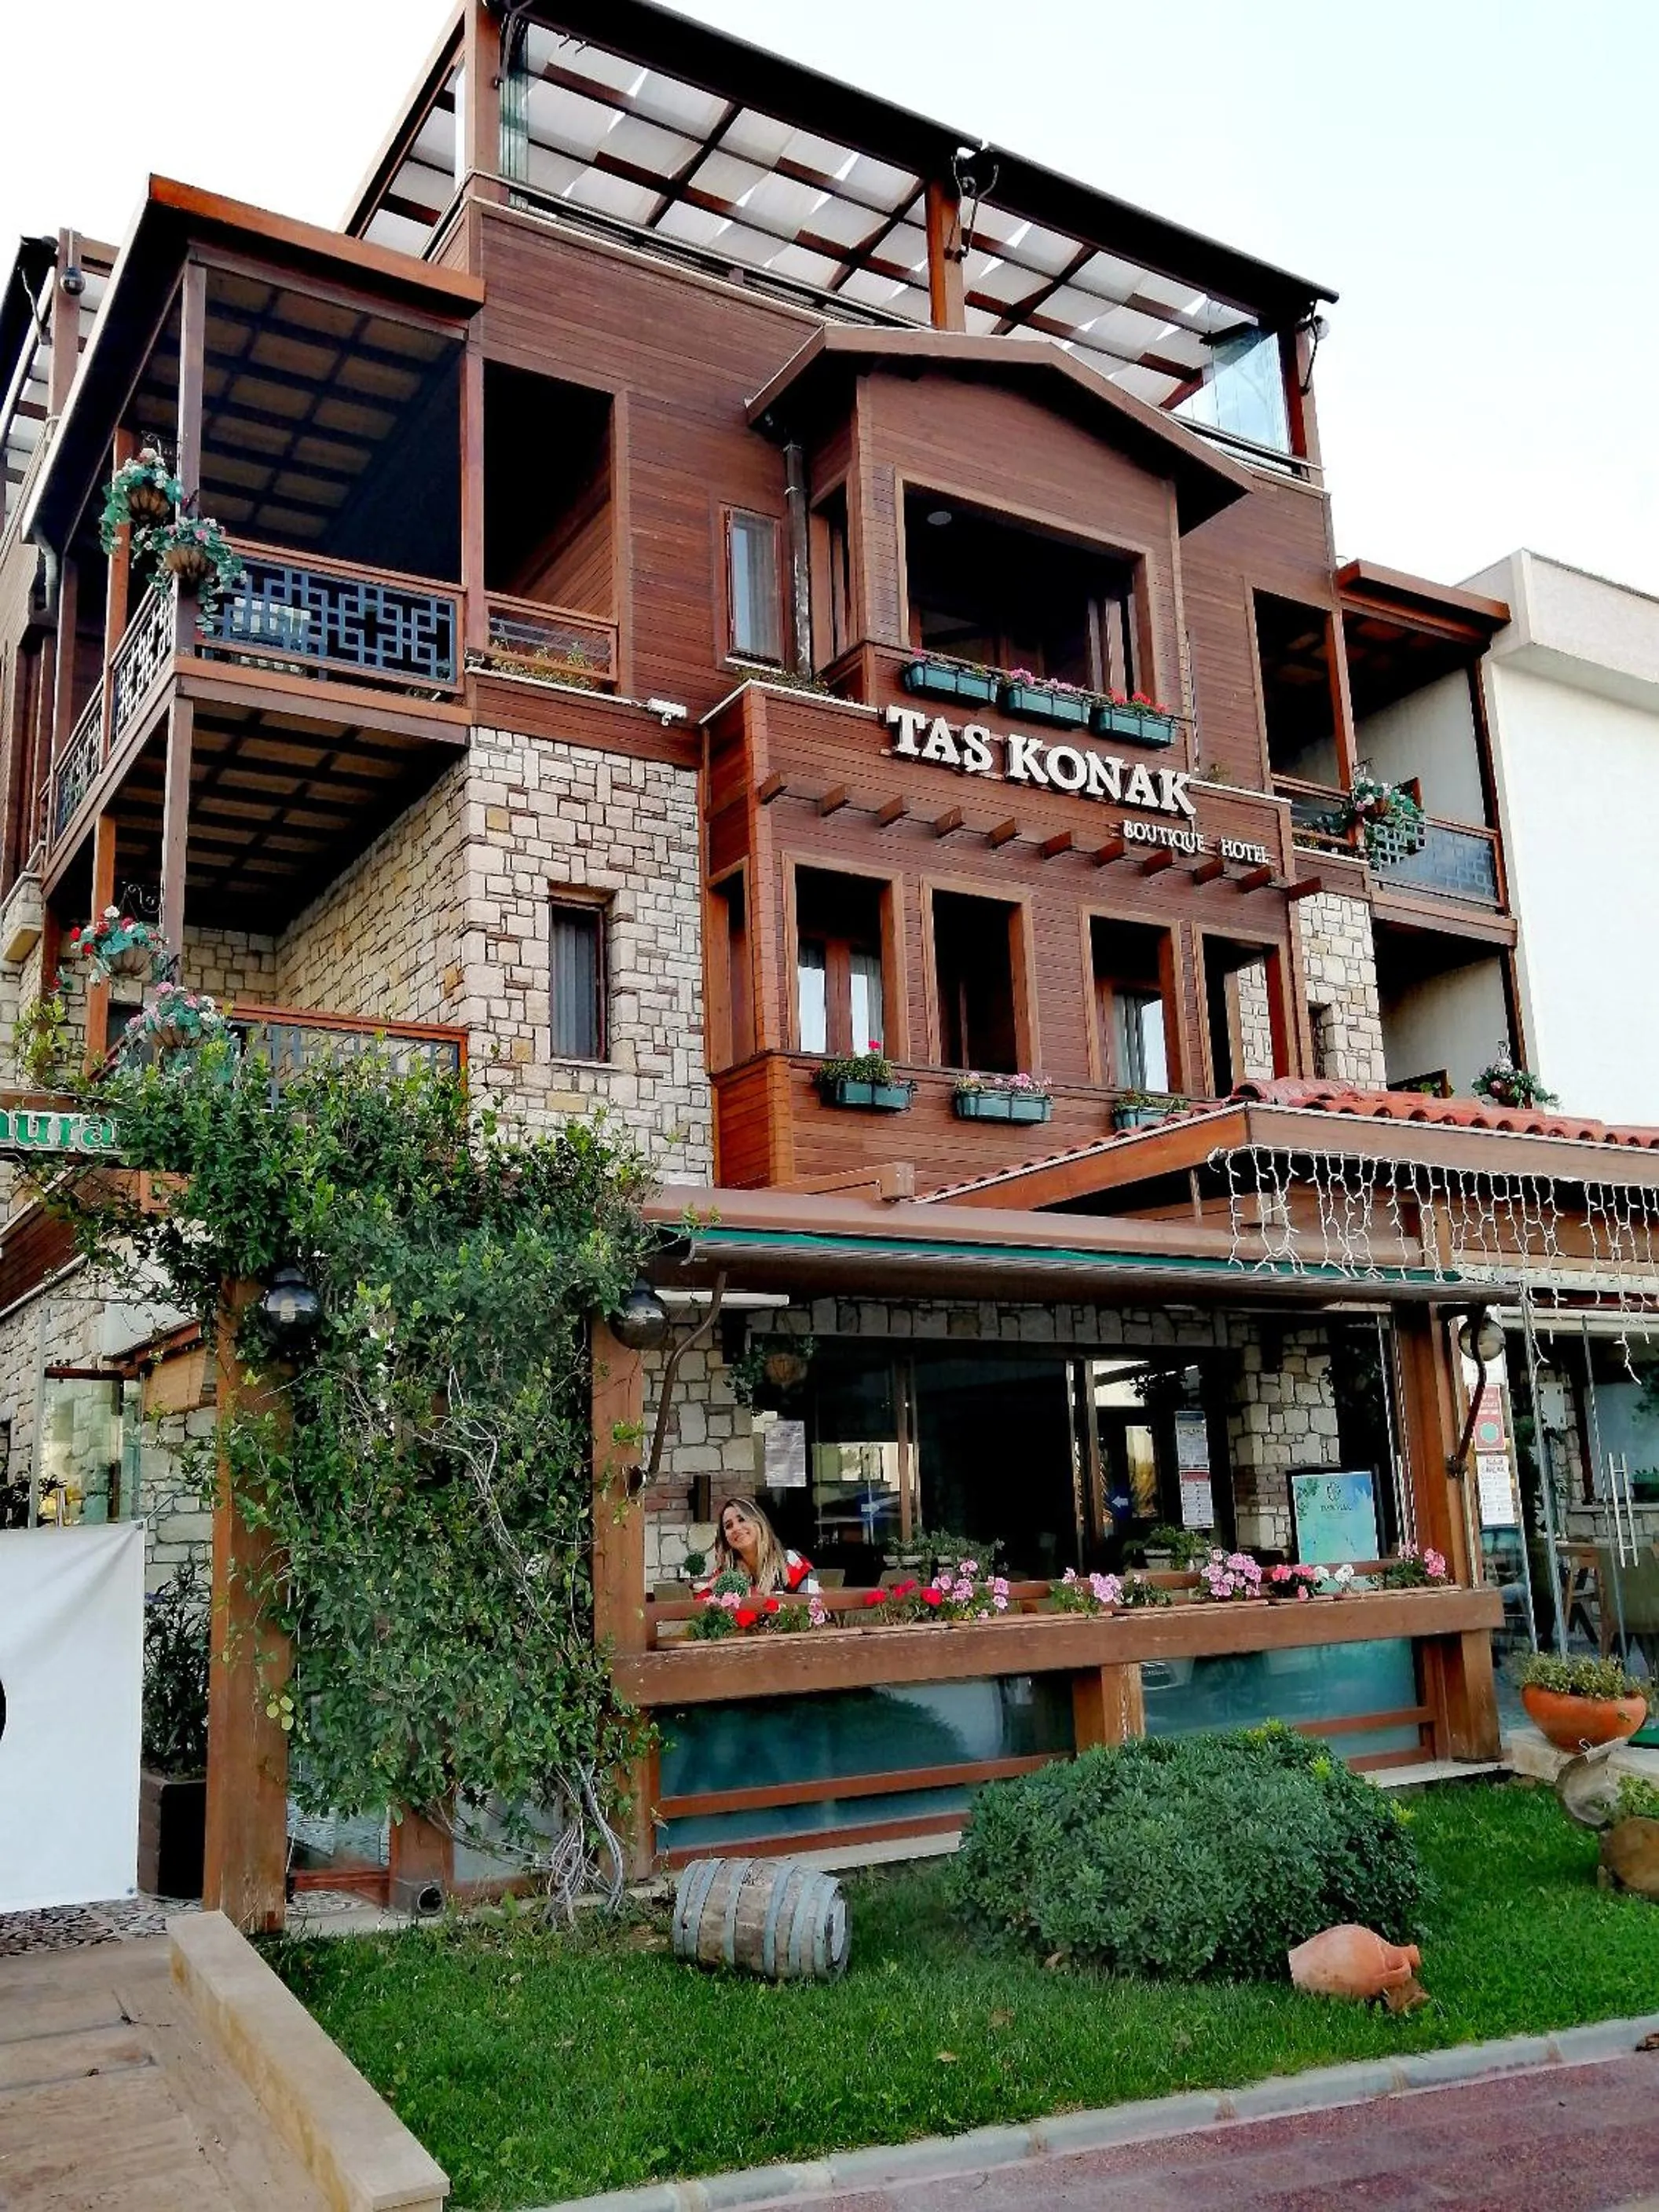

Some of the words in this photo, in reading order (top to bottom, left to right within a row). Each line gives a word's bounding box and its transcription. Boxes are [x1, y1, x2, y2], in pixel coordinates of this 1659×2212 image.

[1008, 733, 1197, 815] KONAK
[1123, 819, 1206, 854] BOUTIQUE
[1221, 837, 1270, 864] HOTEL
